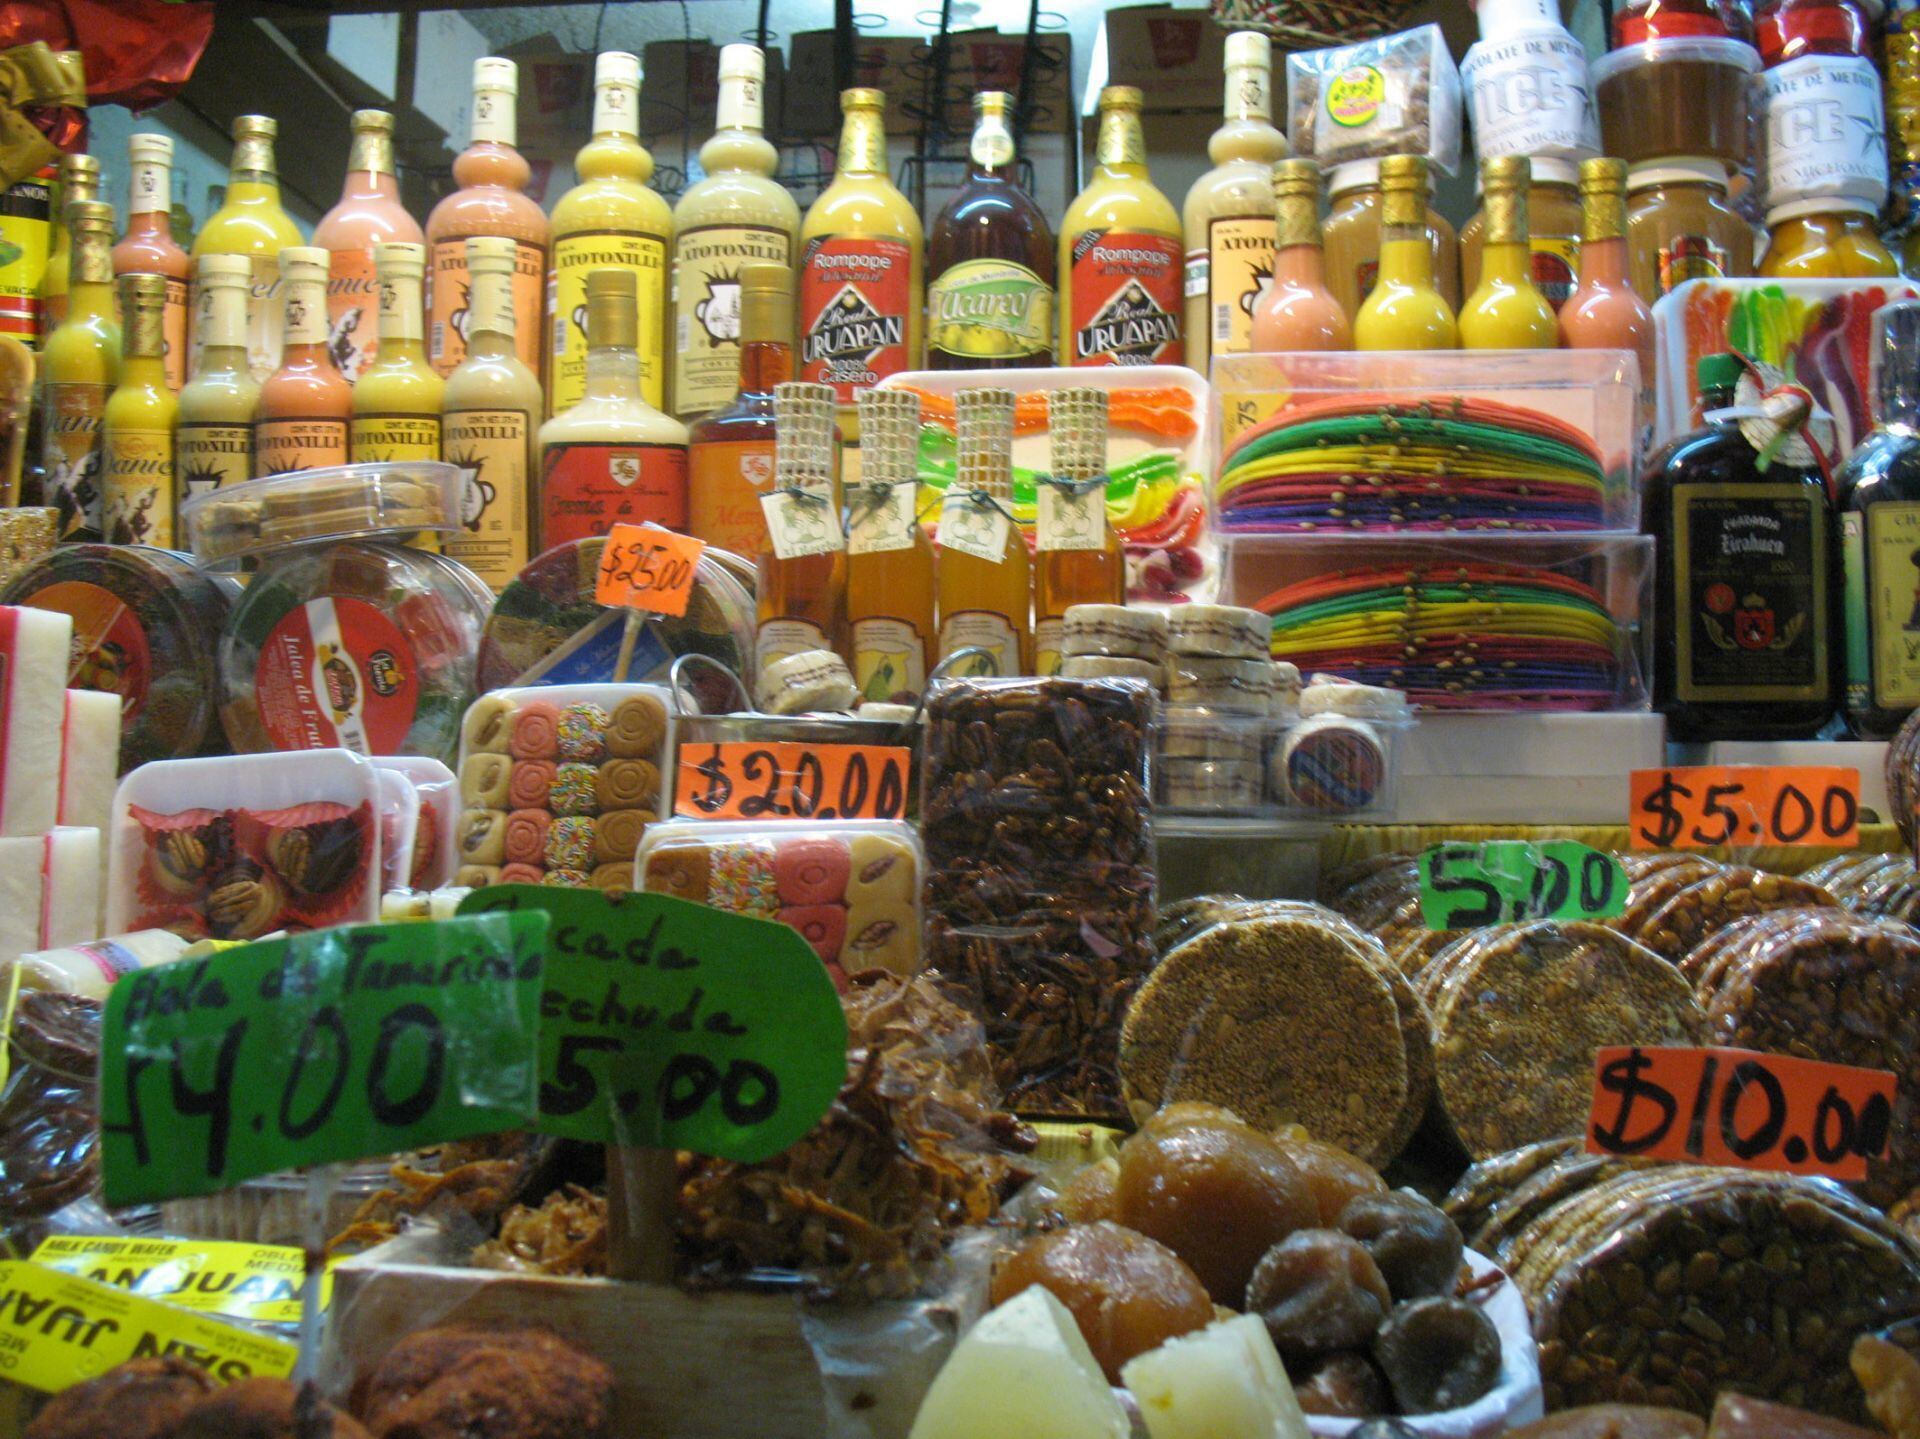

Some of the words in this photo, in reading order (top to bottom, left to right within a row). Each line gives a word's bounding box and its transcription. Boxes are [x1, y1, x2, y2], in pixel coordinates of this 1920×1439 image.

[814, 252, 892, 271] Rompope
[1092, 245, 1171, 266] Rompope
[802, 316, 904, 364] URUAPAN
[1077, 314, 1180, 357] URUAPAN
[817, 367, 879, 384] Casero
[282, 634, 304, 680] Jalea
[295, 683, 313, 704] de
[301, 708, 324, 749] Frut
[691, 743, 902, 820] $20.00
[1640, 773, 1858, 848] $5.00
[1429, 850, 1614, 929] 5.00
[554, 913, 701, 971] cada
[1593, 1048, 1894, 1166] $10.00
[252, 1249, 303, 1260] OBLE
